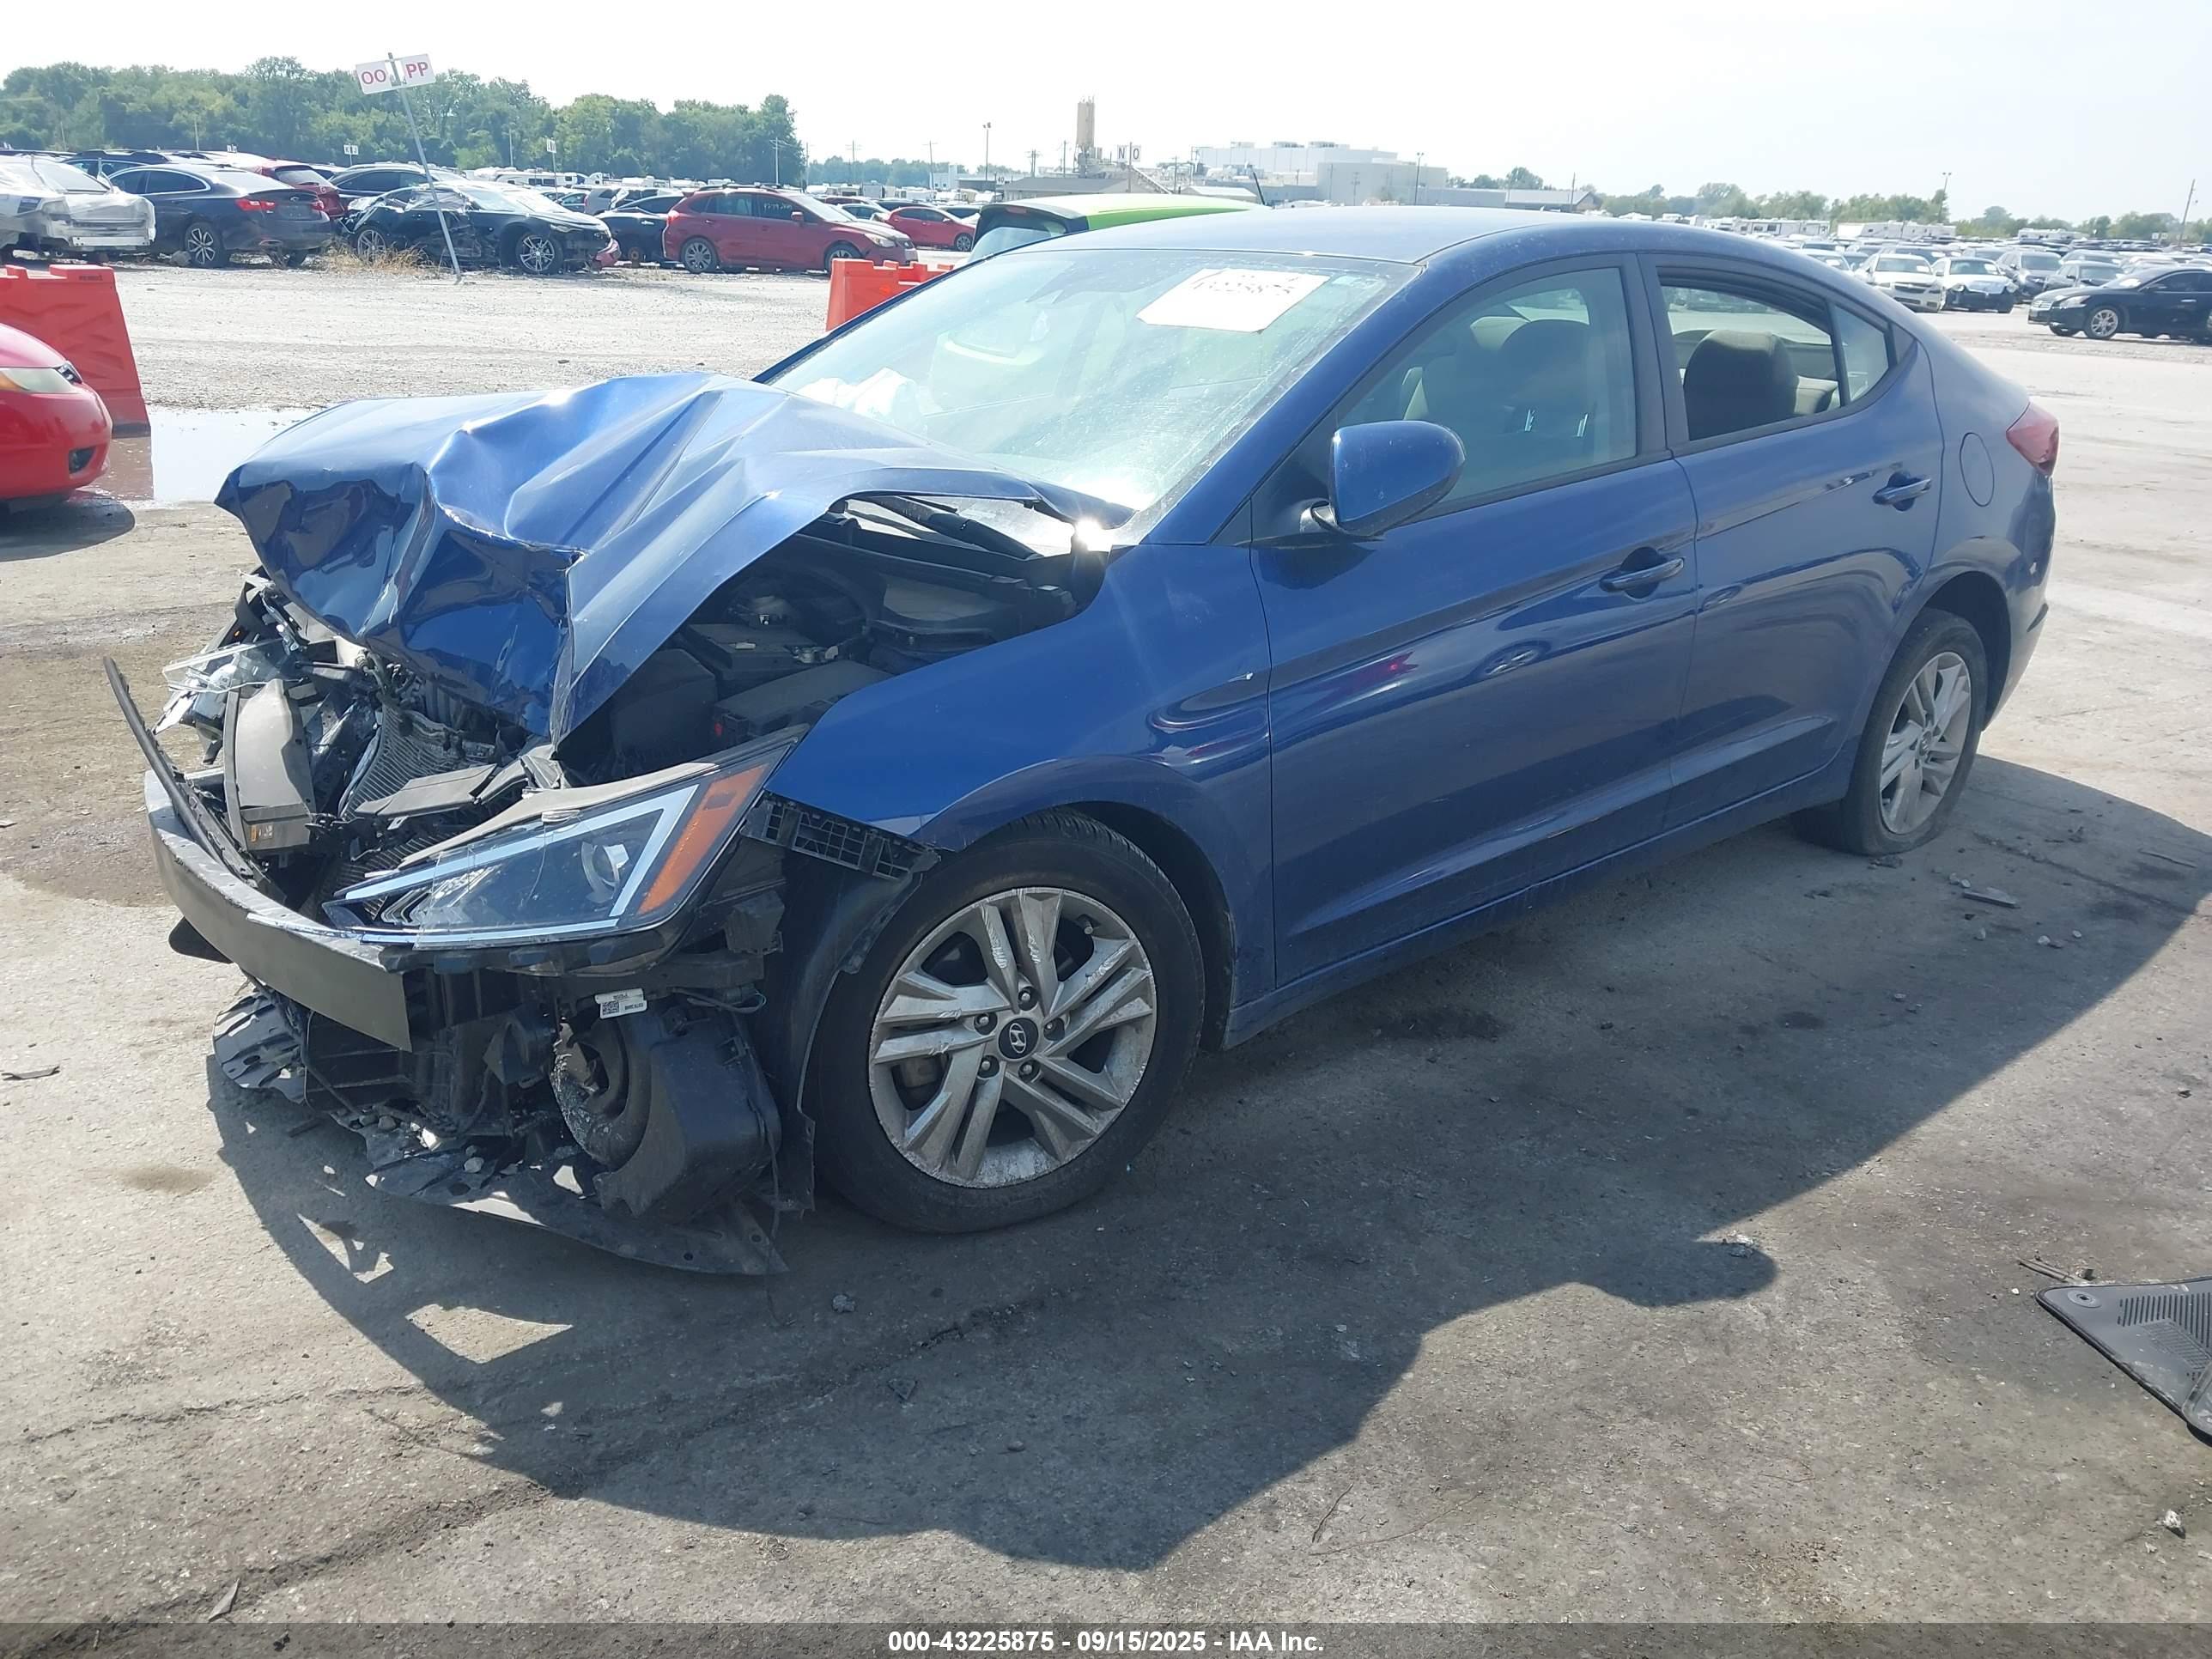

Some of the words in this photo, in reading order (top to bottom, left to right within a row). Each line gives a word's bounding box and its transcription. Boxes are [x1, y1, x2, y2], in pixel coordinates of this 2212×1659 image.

[361, 69, 386, 85] OO
[405, 61, 428, 78] PP
[1118, 147, 1125, 159] N
